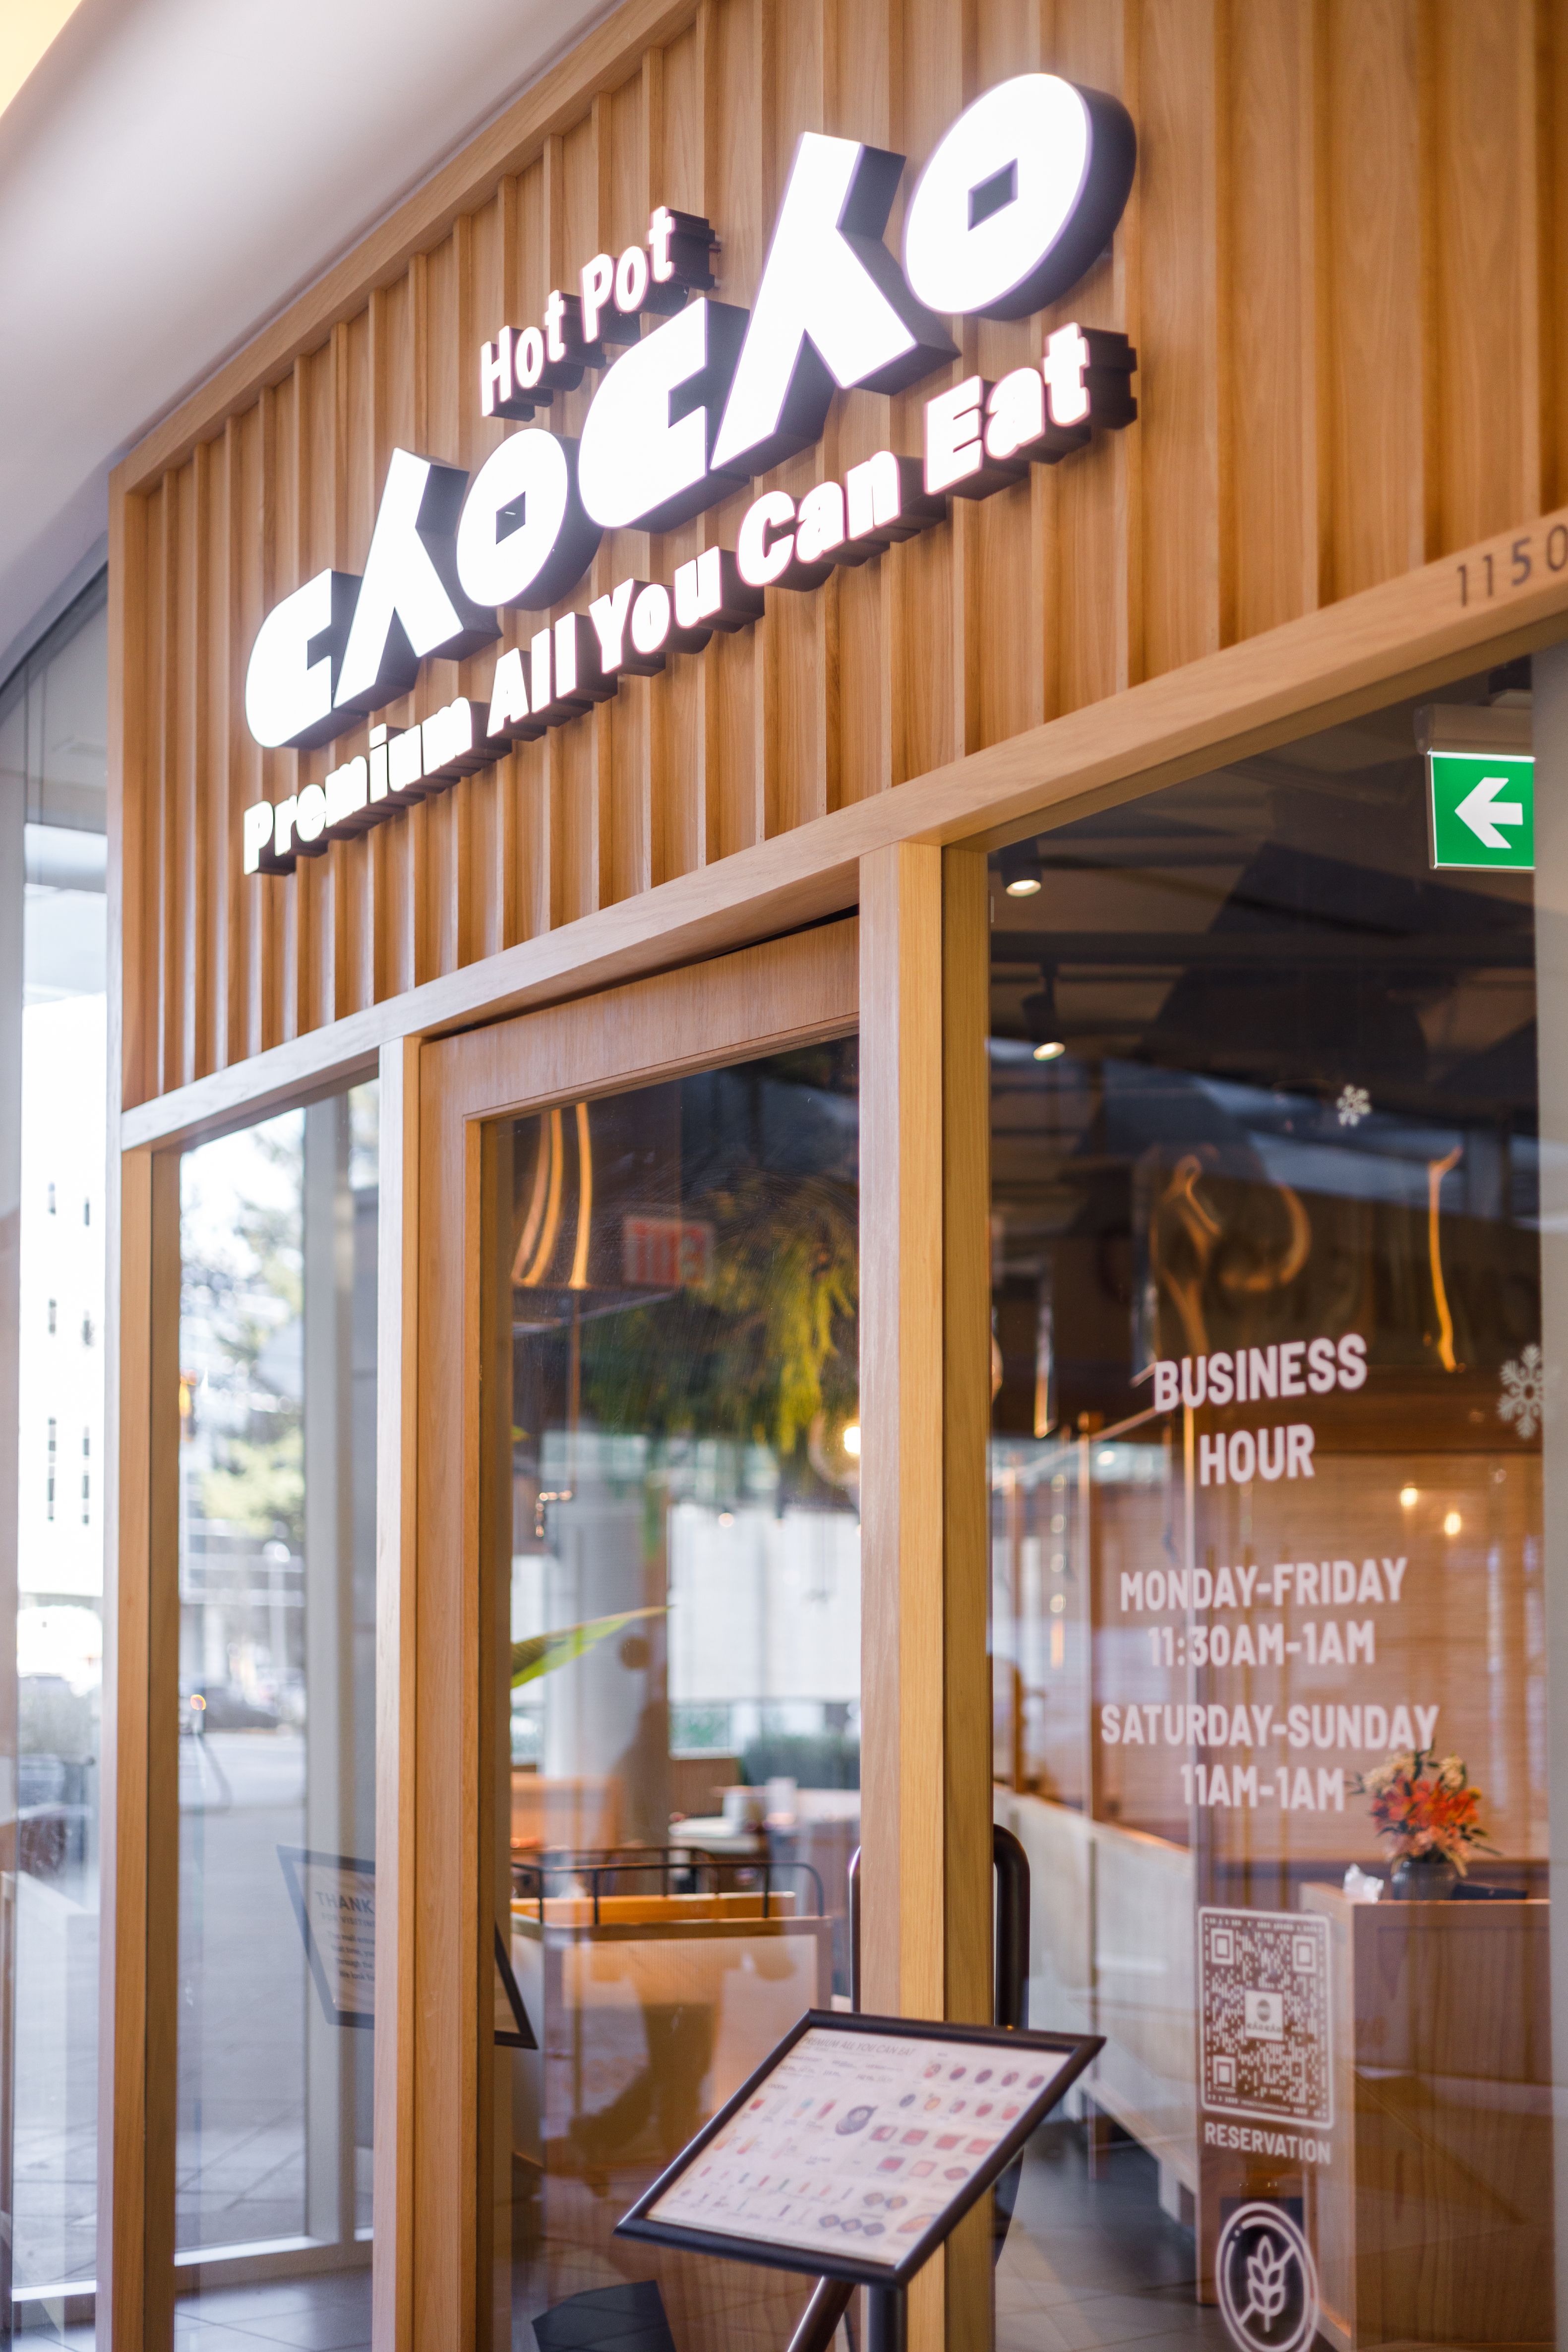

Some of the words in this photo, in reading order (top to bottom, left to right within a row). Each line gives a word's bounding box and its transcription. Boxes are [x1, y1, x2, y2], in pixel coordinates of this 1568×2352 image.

[480, 290, 565, 418] Hot
[581, 205, 676, 343] Pot
[1457, 523, 1568, 608] 1150
[243, 697, 473, 876] Premium
[486, 611, 577, 737] All
[589, 545, 722, 674] You
[736, 450, 901, 587] Can
[924, 322, 1090, 495] Eat
[1153, 1332, 1368, 1412] BUSINESS
[1199, 1423, 1316, 1486] HOUR
[1120, 1557, 1408, 1612] MONDAY-FRIDAY
[1148, 1620, 1376, 1667] 11:30AM-1AM
[1100, 1703, 1440, 1750] SATURDAY-SUNDAY
[1180, 1764, 1345, 1812] 11AM-1AM
[315, 1891, 375, 1915] THANK
[800, 2037, 841, 2048] PREMIUM
[841, 2040, 855, 2050] ALL
[856, 2043, 877, 2053] YOU
[876, 2045, 898, 2054] CAN
[1204, 2121, 1331, 2166] RESERVATION
